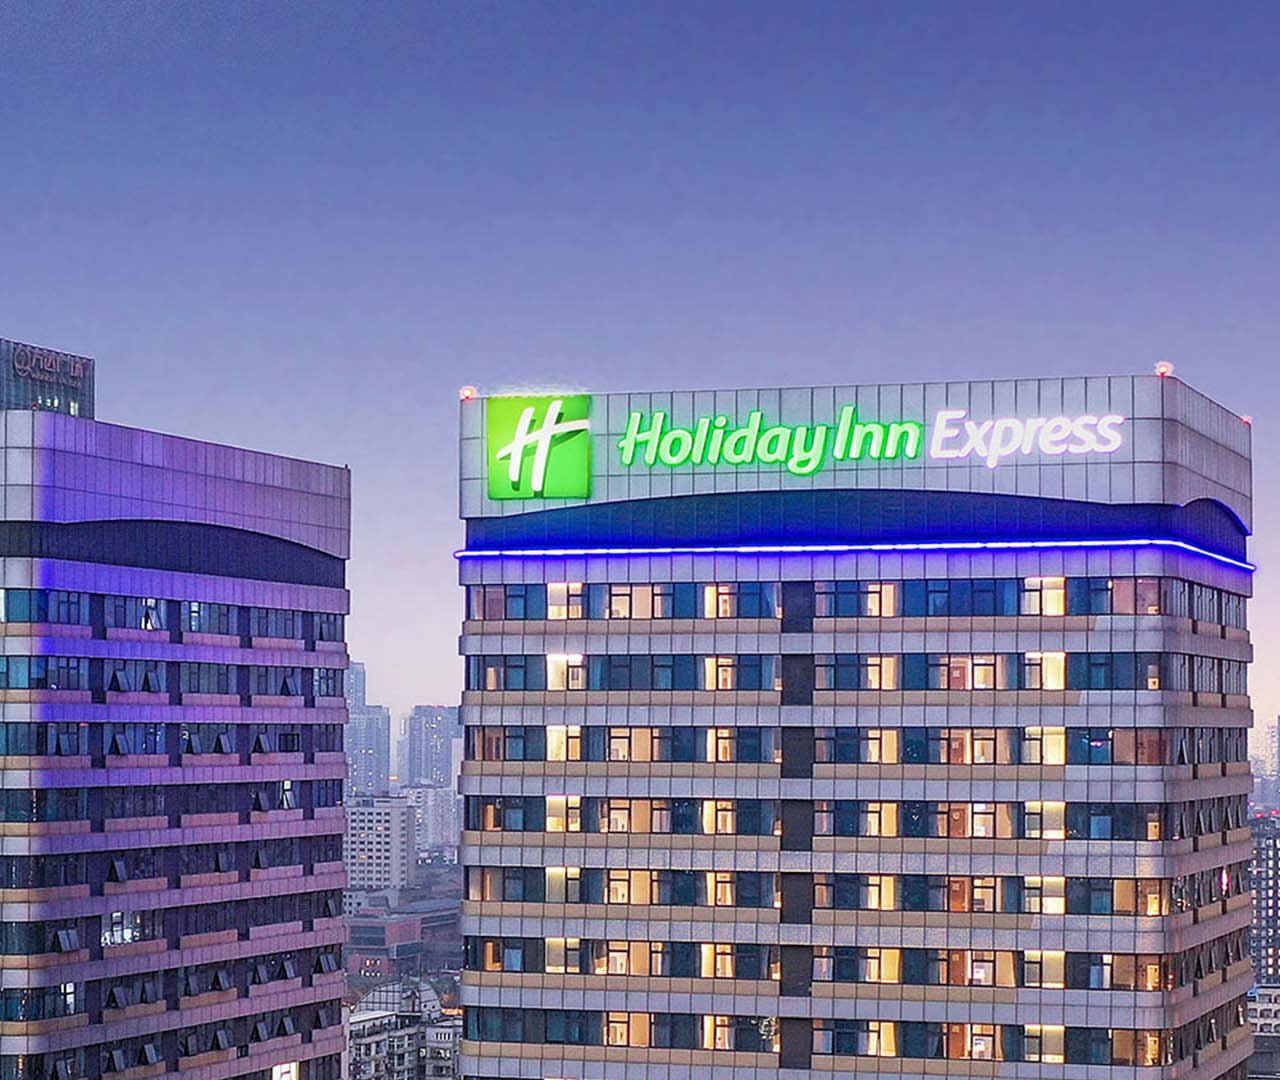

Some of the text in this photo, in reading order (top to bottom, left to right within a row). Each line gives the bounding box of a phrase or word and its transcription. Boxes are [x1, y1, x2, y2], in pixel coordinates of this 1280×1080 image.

[617, 405, 1125, 475] Holiday Inn Express
